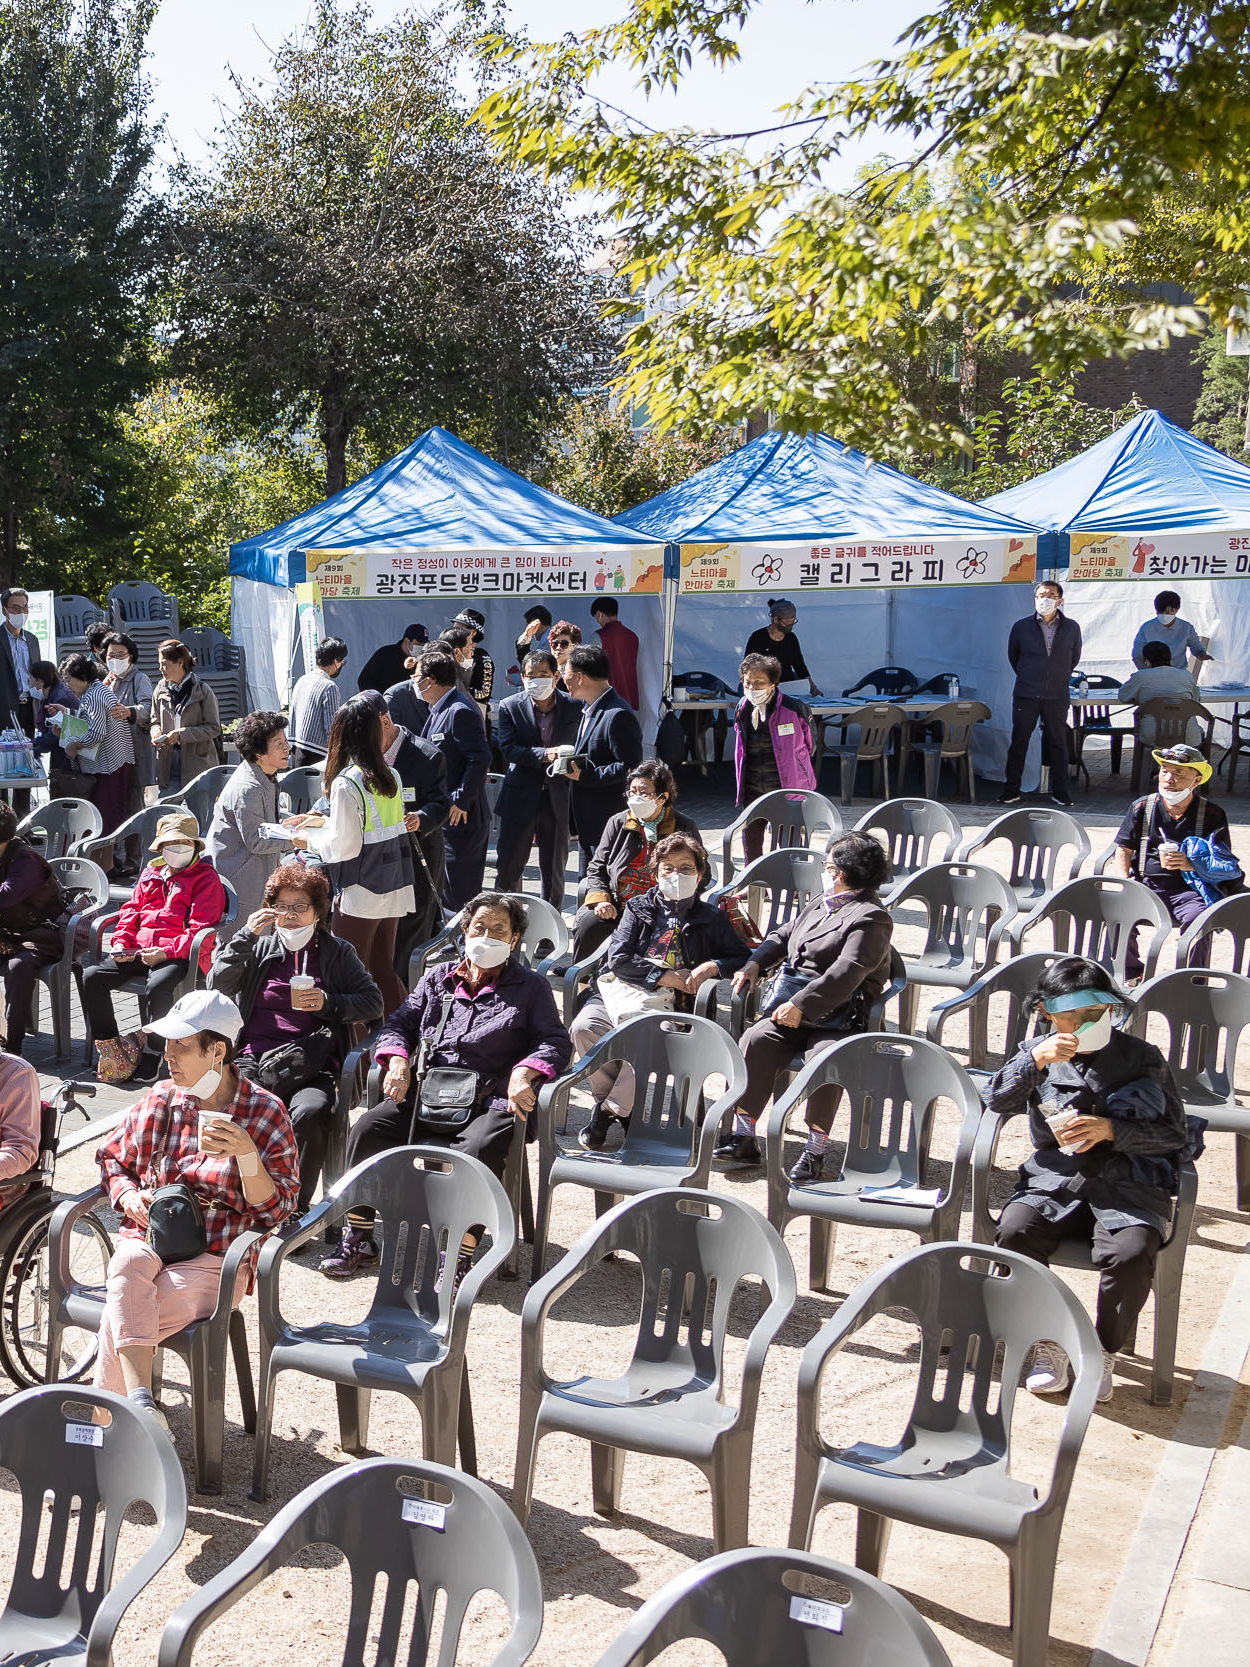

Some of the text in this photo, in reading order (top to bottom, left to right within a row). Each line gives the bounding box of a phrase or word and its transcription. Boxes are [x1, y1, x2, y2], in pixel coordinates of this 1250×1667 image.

[810, 547, 831, 560] 좋은
[871, 545, 935, 558] 적어드립니다
[391, 556, 573, 570] 작은 정성이 이웃에게 큰 힘이 됩니다
[1080, 557, 1117, 567] 느티마을
[1148, 555, 1228, 576] 찾아가는
[690, 567, 728, 578] 느티마을
[800, 559, 944, 586] 캘리그라피
[1073, 568, 1123, 579] 한마당 축제
[375, 570, 587, 595] 광진푸드뱅크마켓센터
[684, 579, 736, 590] 한마당 축제
[319, 586, 361, 597] 마당 축제
